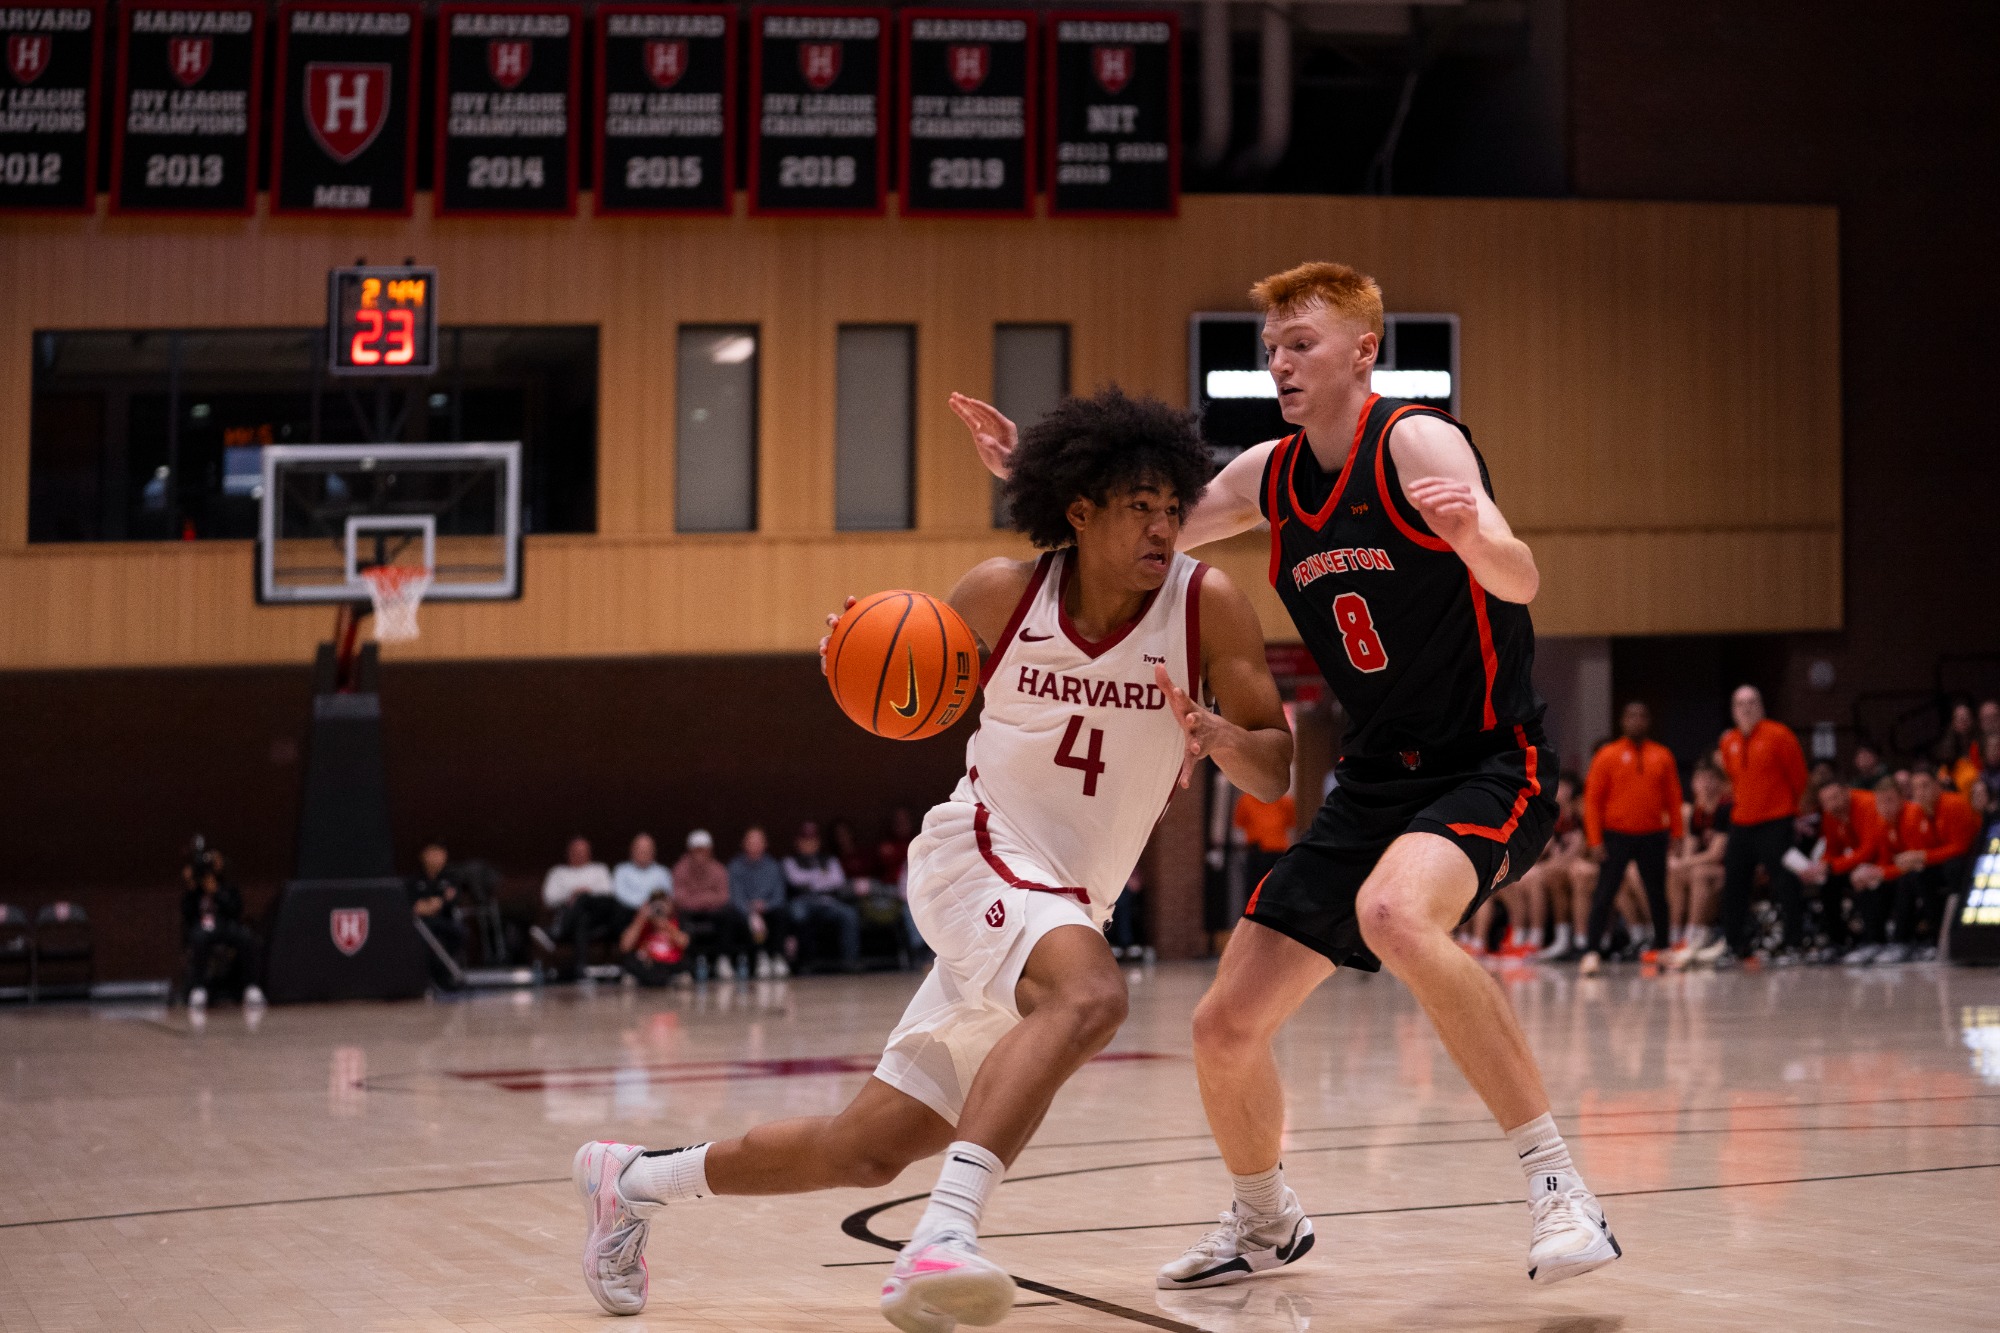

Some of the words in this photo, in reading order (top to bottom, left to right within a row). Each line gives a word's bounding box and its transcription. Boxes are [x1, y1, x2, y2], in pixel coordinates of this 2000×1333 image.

[134, 11, 252, 32] HARVARD
[292, 13, 410, 34] HARVARD
[326, 74, 367, 132] H
[0, 154, 61, 184] 012
[147, 155, 222, 186] 2013
[469, 157, 543, 187] 2014
[627, 157, 701, 187] 2015
[314, 186, 370, 207] MEN
[351, 309, 414, 366] 23
[1292, 547, 1395, 592] PRINCETON
[1332, 591, 1389, 674] 8
[935, 651, 970, 726] ELITE
[1017, 665, 1166, 711] HARVARD
[1053, 714, 1106, 797] 4
[987, 903, 1004, 926] H
